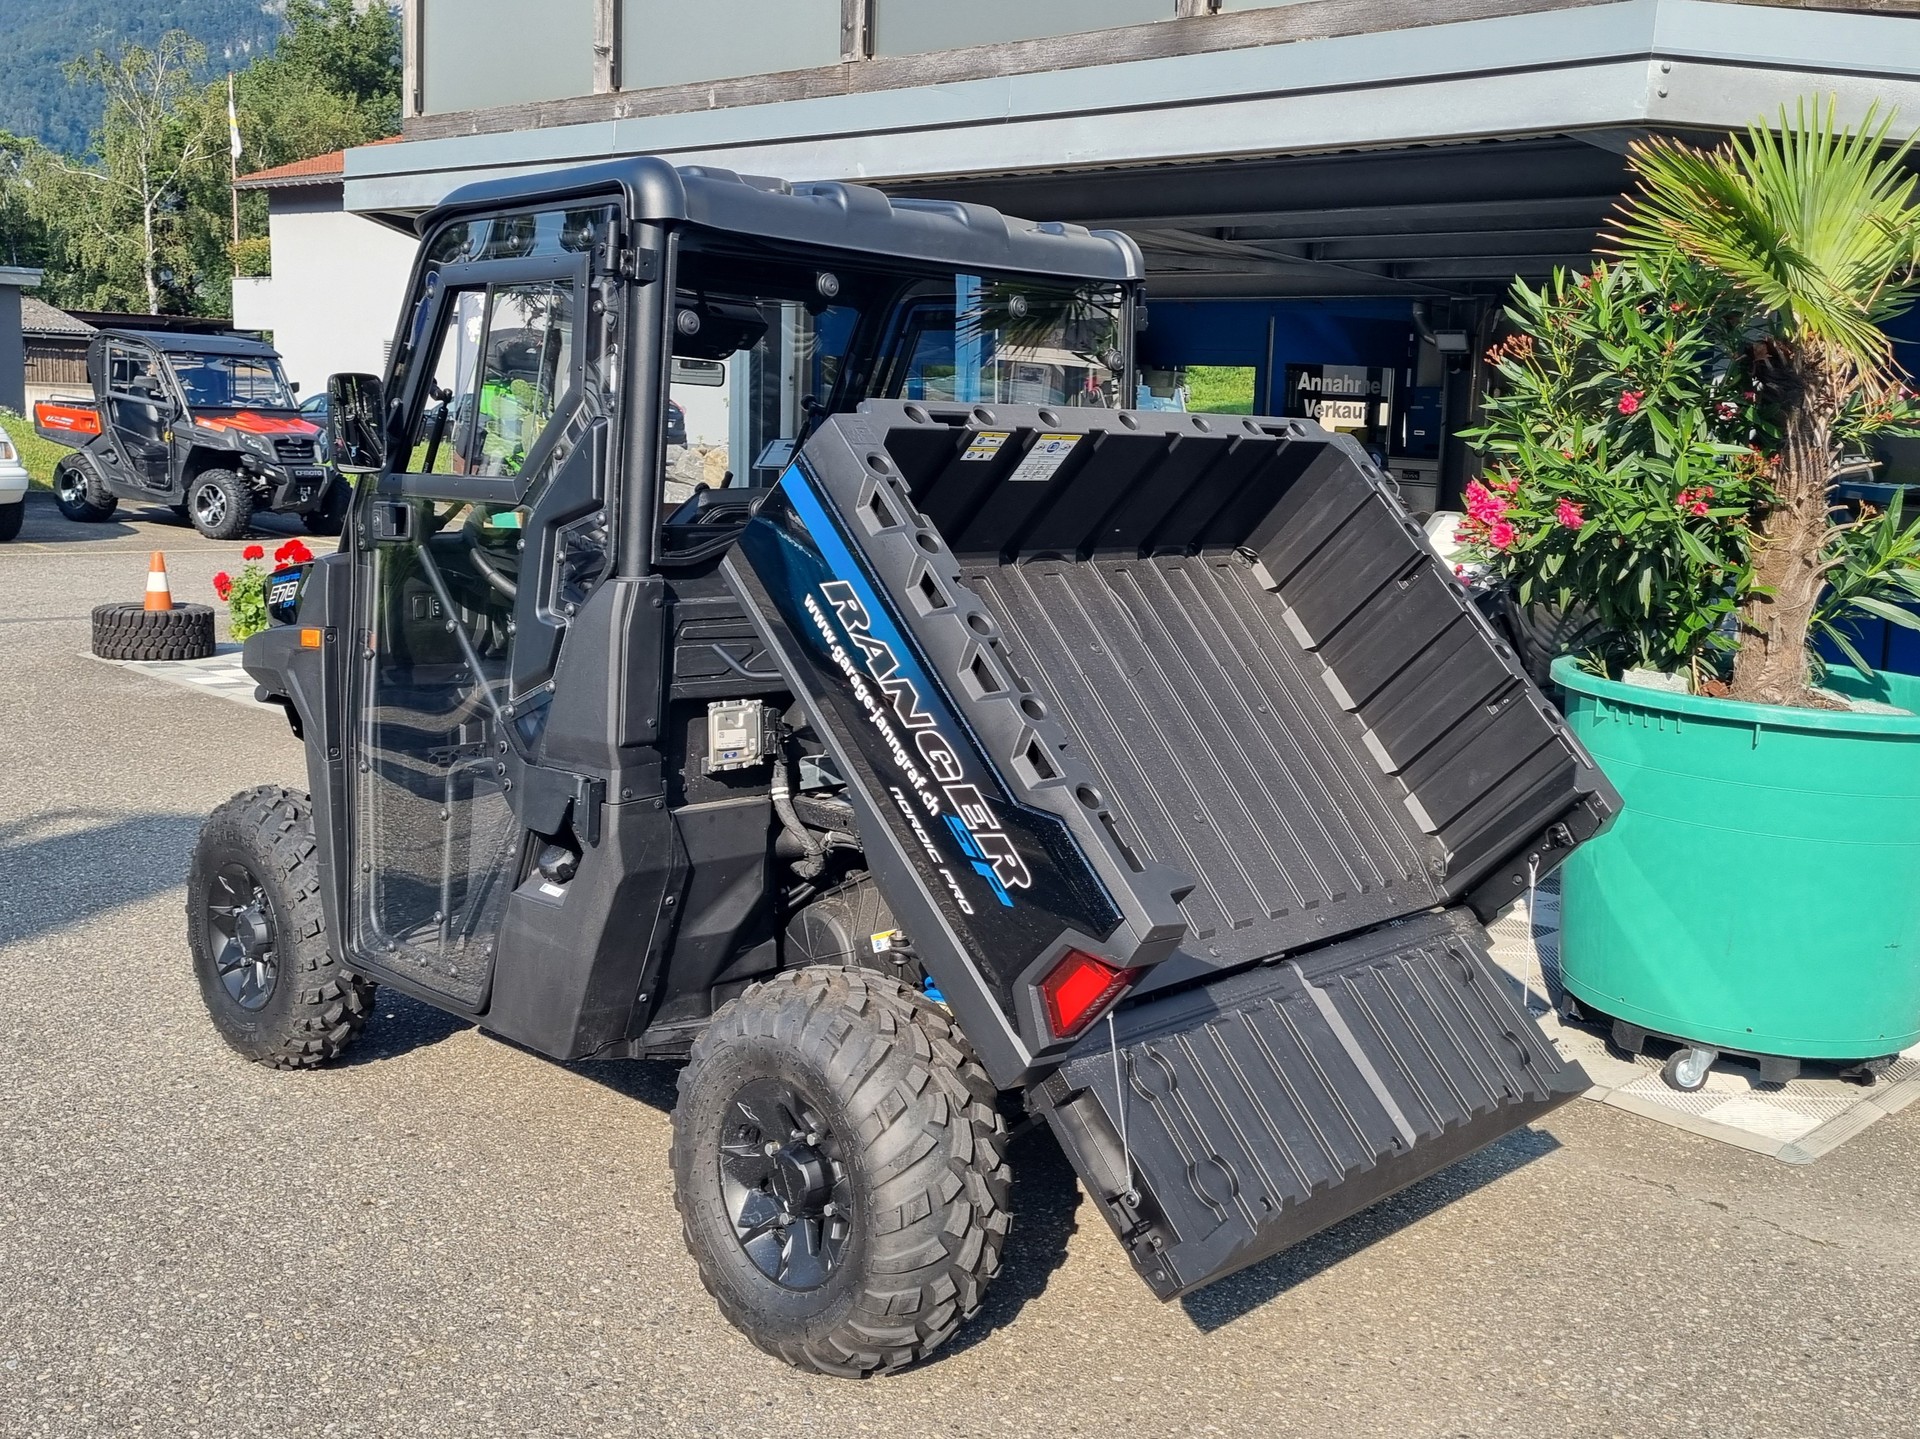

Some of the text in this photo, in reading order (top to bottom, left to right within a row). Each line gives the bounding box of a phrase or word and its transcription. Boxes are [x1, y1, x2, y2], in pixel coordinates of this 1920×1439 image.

[1297, 371, 1381, 394] Annahme
[1303, 399, 1371, 420] Verkauf
[268, 581, 299, 605] 570
[803, 594, 940, 818] www.garage-janngraf.ch
[819, 580, 1032, 890] RANGER
[939, 868, 975, 915] PRO
